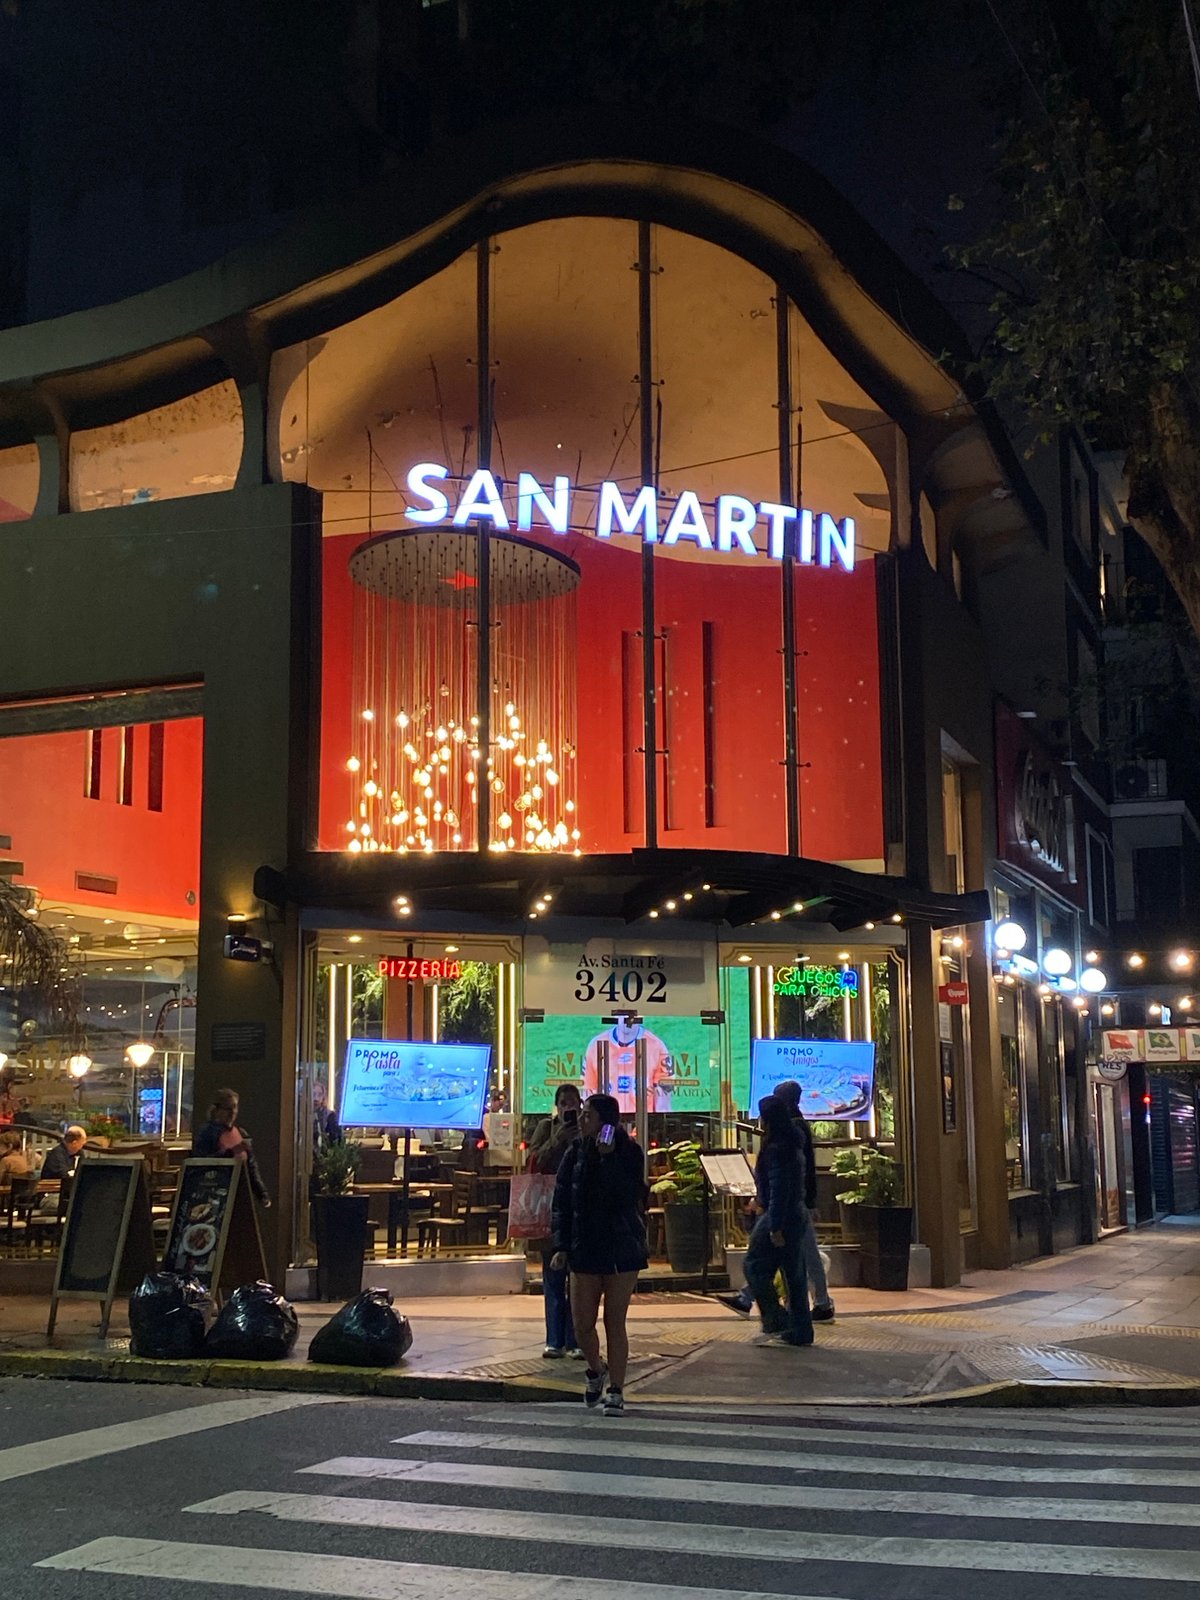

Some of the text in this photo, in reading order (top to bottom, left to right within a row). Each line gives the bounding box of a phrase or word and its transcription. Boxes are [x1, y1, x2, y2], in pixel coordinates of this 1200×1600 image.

[404, 461, 858, 573] SAN MARTIN
[378, 957, 461, 978] PIZZERÍA
[578, 954, 665, 970] Av. Santa Fé
[790, 970, 842, 984] JUEGOS
[575, 969, 667, 1003] 3402
[772, 983, 859, 999] PARA CHICOS
[355, 1049, 399, 1060] PROMO
[776, 1047, 814, 1057] PROMO
[362, 1054, 401, 1074] Pasta
[532, 1086, 553, 1097] SAN
